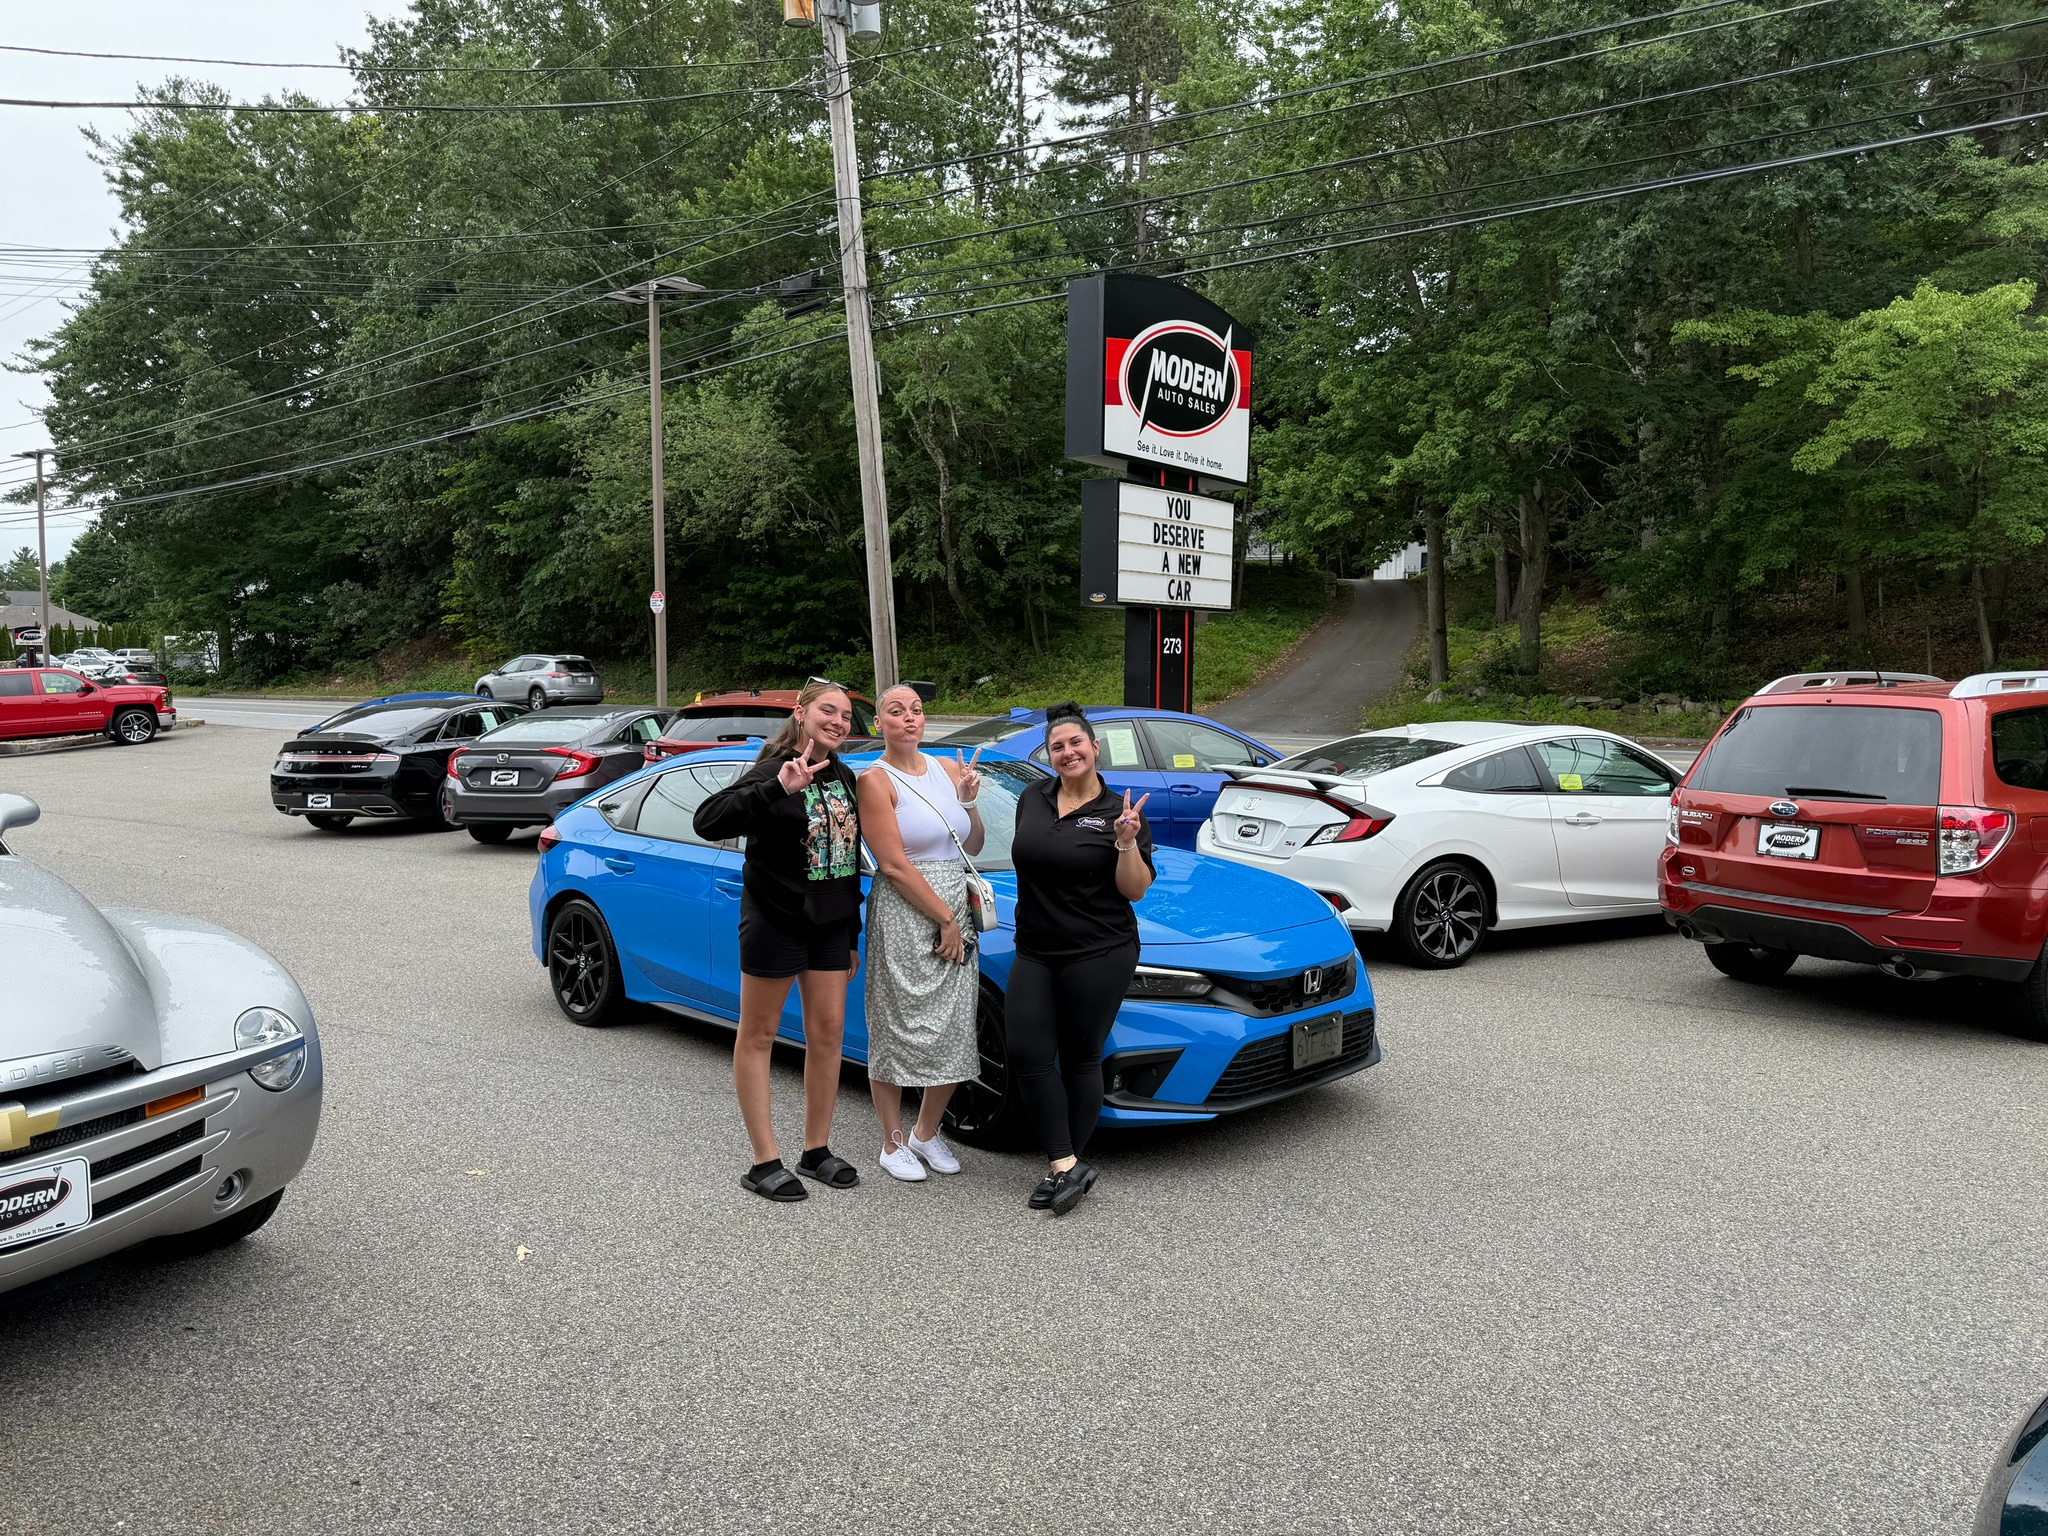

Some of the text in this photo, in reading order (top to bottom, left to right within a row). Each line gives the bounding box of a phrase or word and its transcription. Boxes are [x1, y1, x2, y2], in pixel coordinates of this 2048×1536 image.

[1157, 387, 1216, 416] AUTO SALES
[1137, 440, 1150, 453] See
[1159, 446, 1174, 459] Love
[1184, 452, 1199, 466] Drive
[1200, 455, 1205, 465] it
[1206, 458, 1224, 471] home.
[1166, 496, 1191, 521] YOU
[1153, 522, 1205, 550] DESERVE
[1162, 551, 1202, 576] A NEW
[1167, 579, 1192, 602] CAR
[1163, 637, 1182, 655] 273
[18, 1203, 49, 1216] SALES
[16, 1230, 32, 1239] Drive
[38, 1225, 55, 1233] home.
